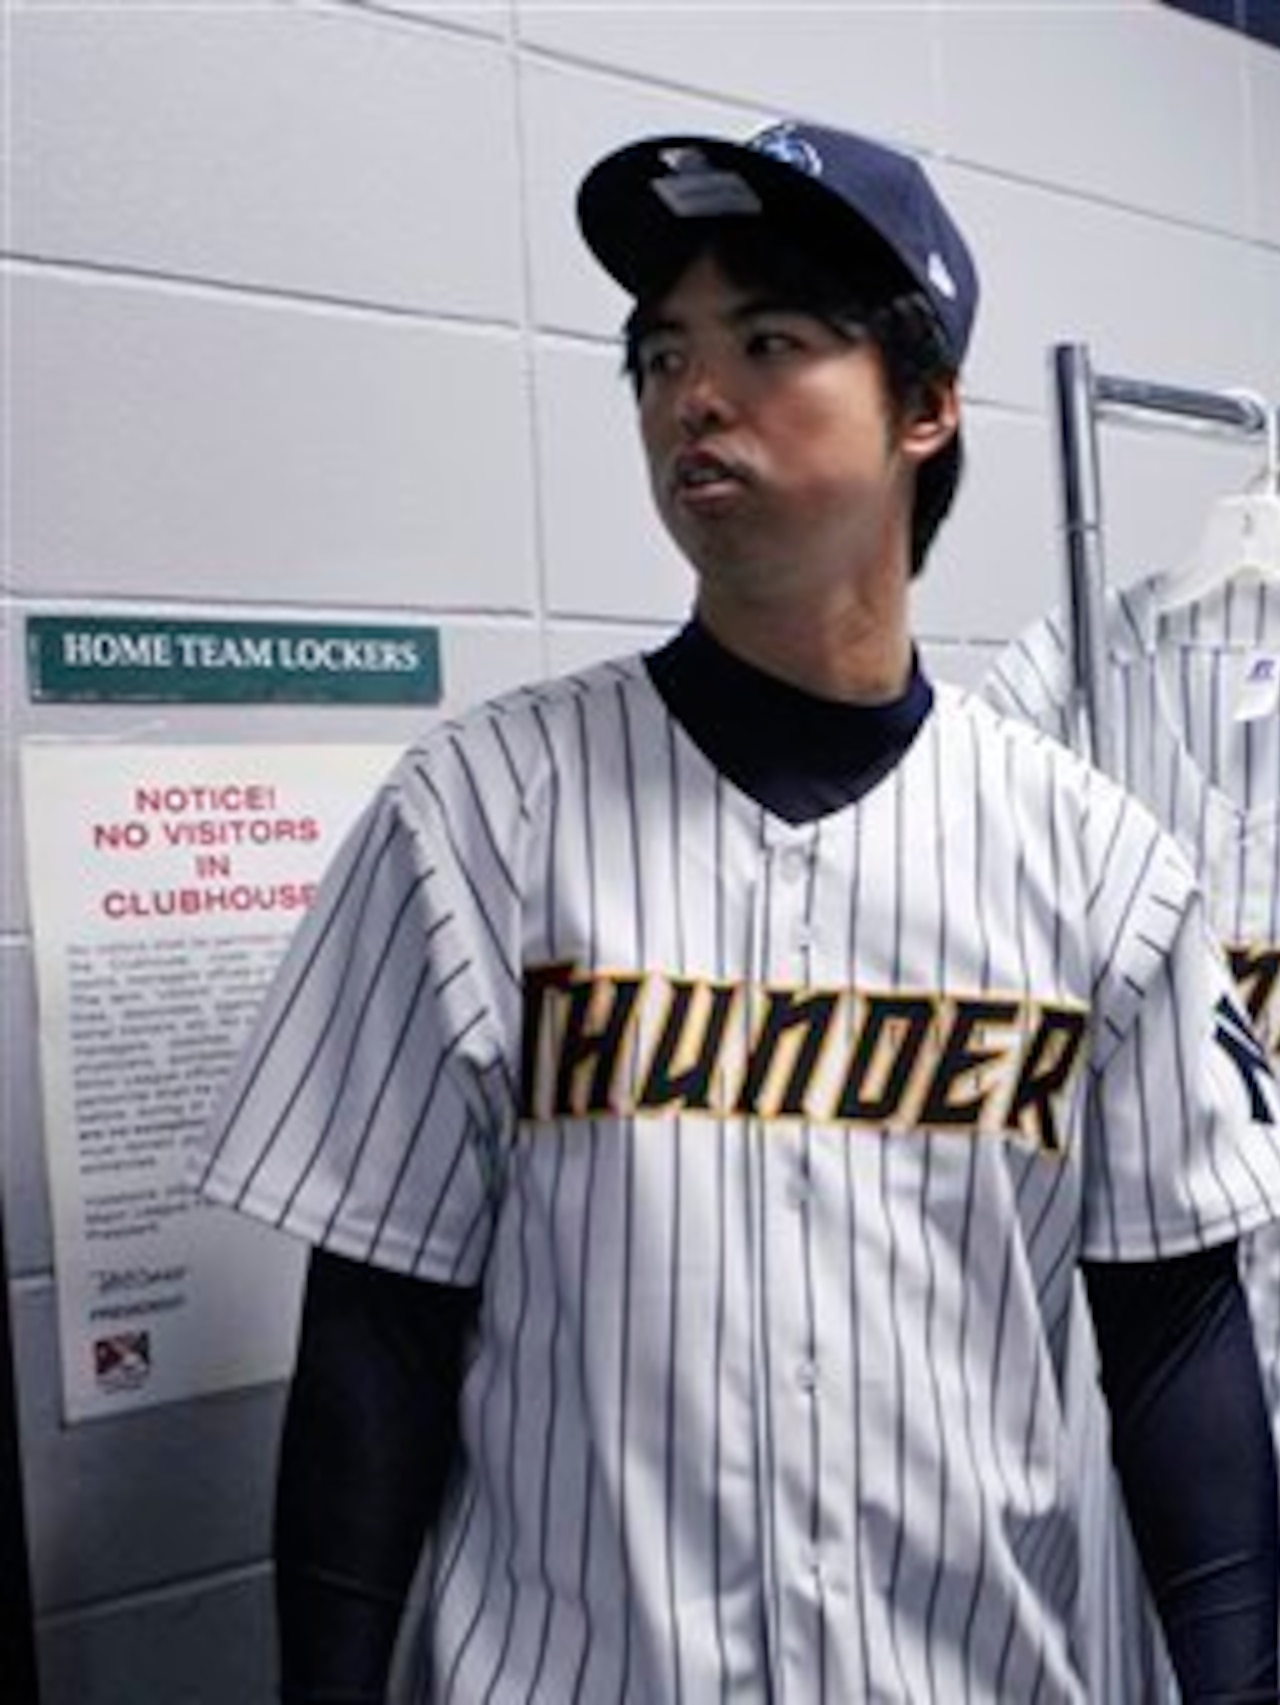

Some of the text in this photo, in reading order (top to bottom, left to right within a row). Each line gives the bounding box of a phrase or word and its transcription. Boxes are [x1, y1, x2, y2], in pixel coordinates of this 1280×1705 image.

[63, 633, 419, 672] HOME TEAM LOCKERS
[135, 786, 277, 813] NOTICE!
[94, 817, 320, 850] NO VISITORS
[195, 855, 230, 877] IN
[102, 884, 318, 919] CLUBHOUSE
[518, 958, 1092, 1154] THUNDER
